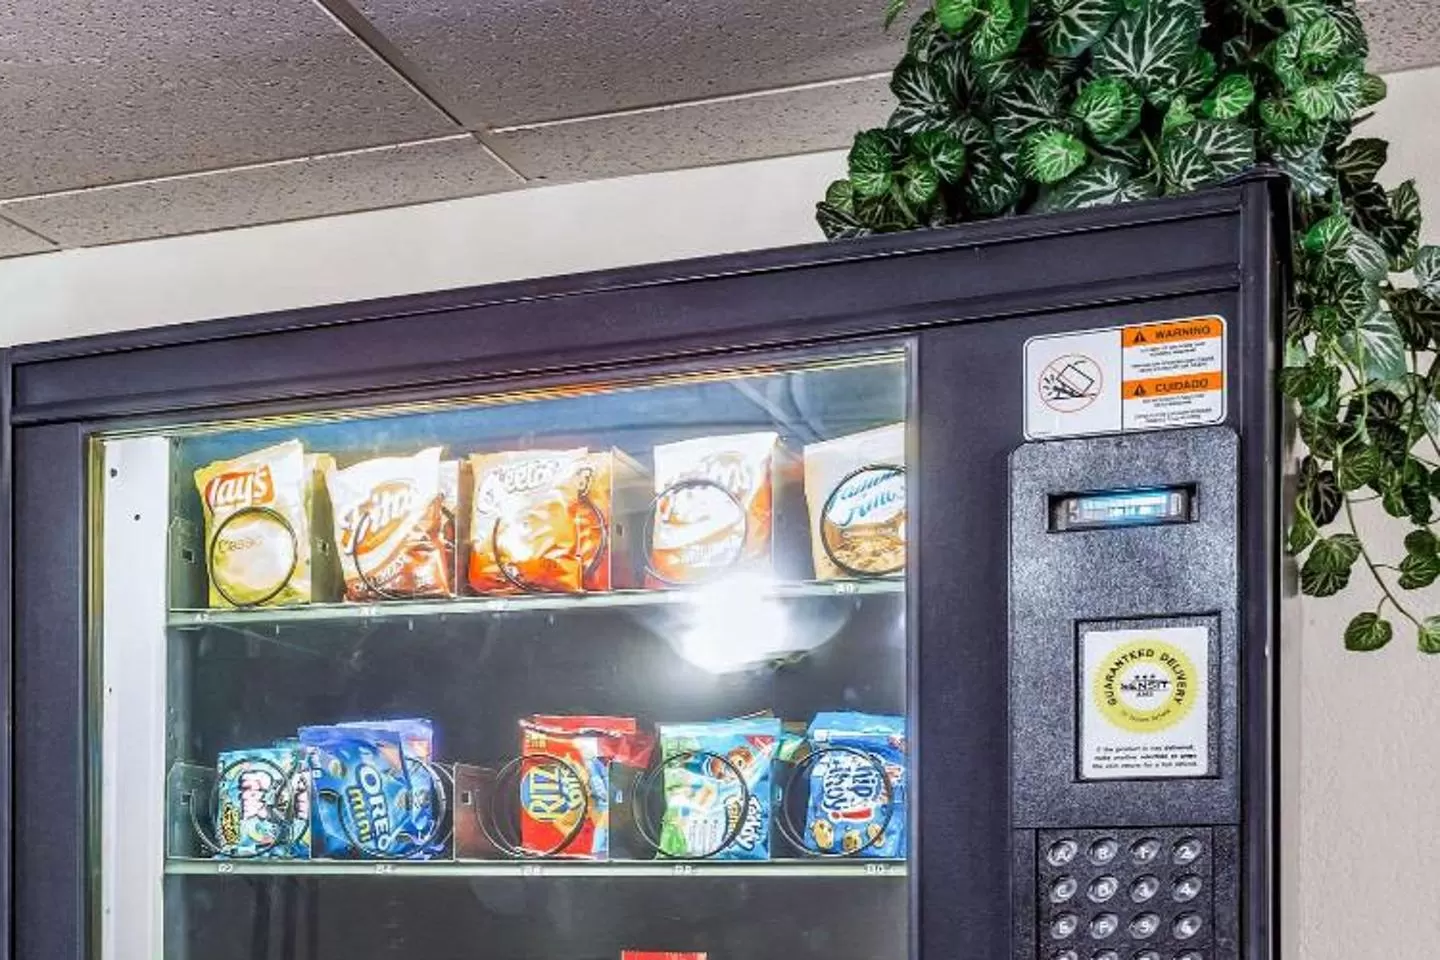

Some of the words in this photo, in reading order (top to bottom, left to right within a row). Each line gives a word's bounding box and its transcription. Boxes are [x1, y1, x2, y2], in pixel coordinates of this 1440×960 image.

[1155, 325, 1211, 339] WARNING
[1155, 378, 1209, 393] CUIDADO
[1104, 648, 1155, 706] GUARANTEED
[1160, 652, 1188, 705] DELIVERY
[359, 764, 392, 852] OREO
[529, 765, 563, 820] RITZ
